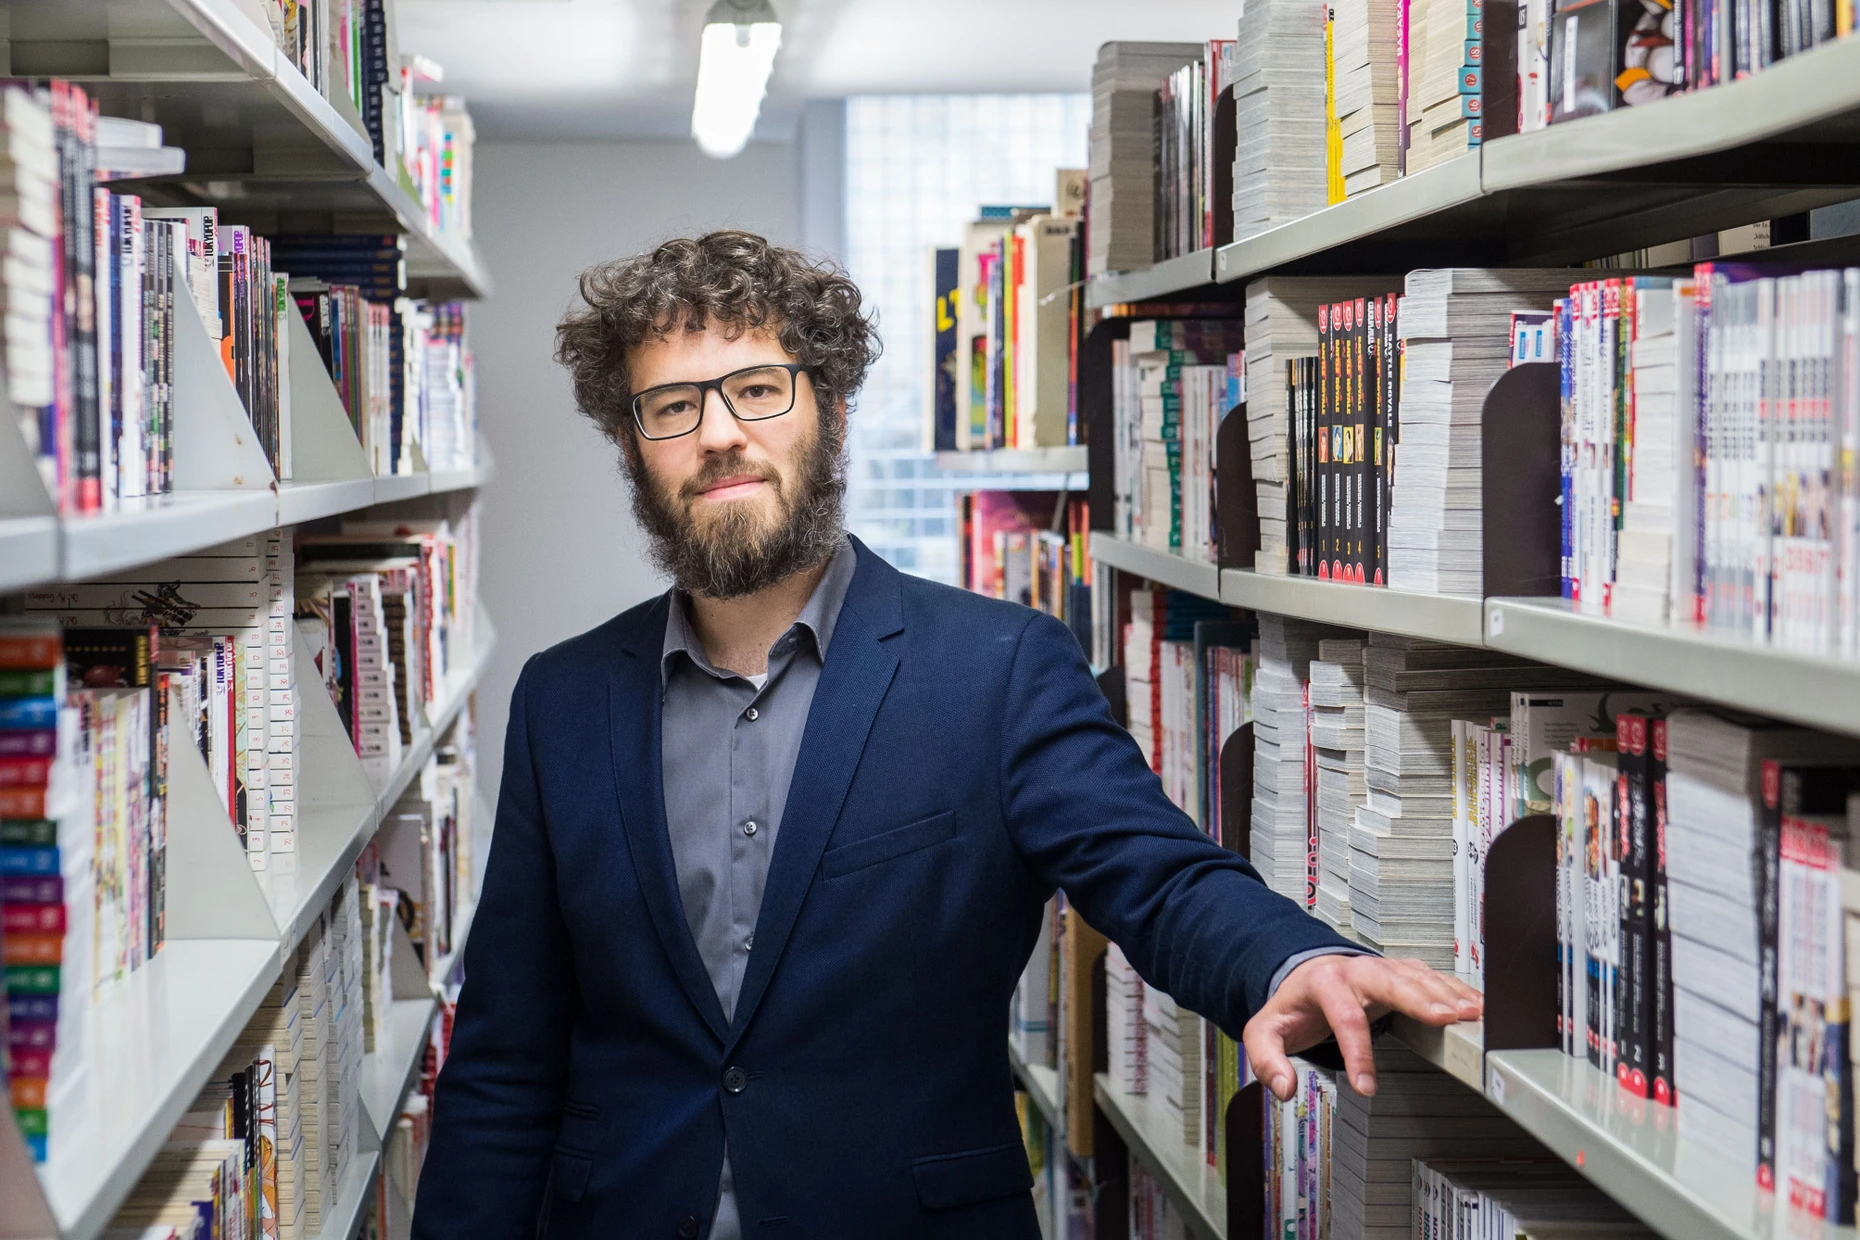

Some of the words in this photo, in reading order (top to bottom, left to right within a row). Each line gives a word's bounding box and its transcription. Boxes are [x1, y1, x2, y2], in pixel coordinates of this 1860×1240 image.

[1466, 75, 1476, 85] 17
[1468, 100, 1480, 110] 16
[203, 216, 214, 257] TOKYOPOP
[28, 593, 55, 603] Goddess
[214, 642, 224, 684] TOKYOPOP
[1633, 1044, 1642, 1062] 2
[1658, 1052, 1666, 1071] 3
